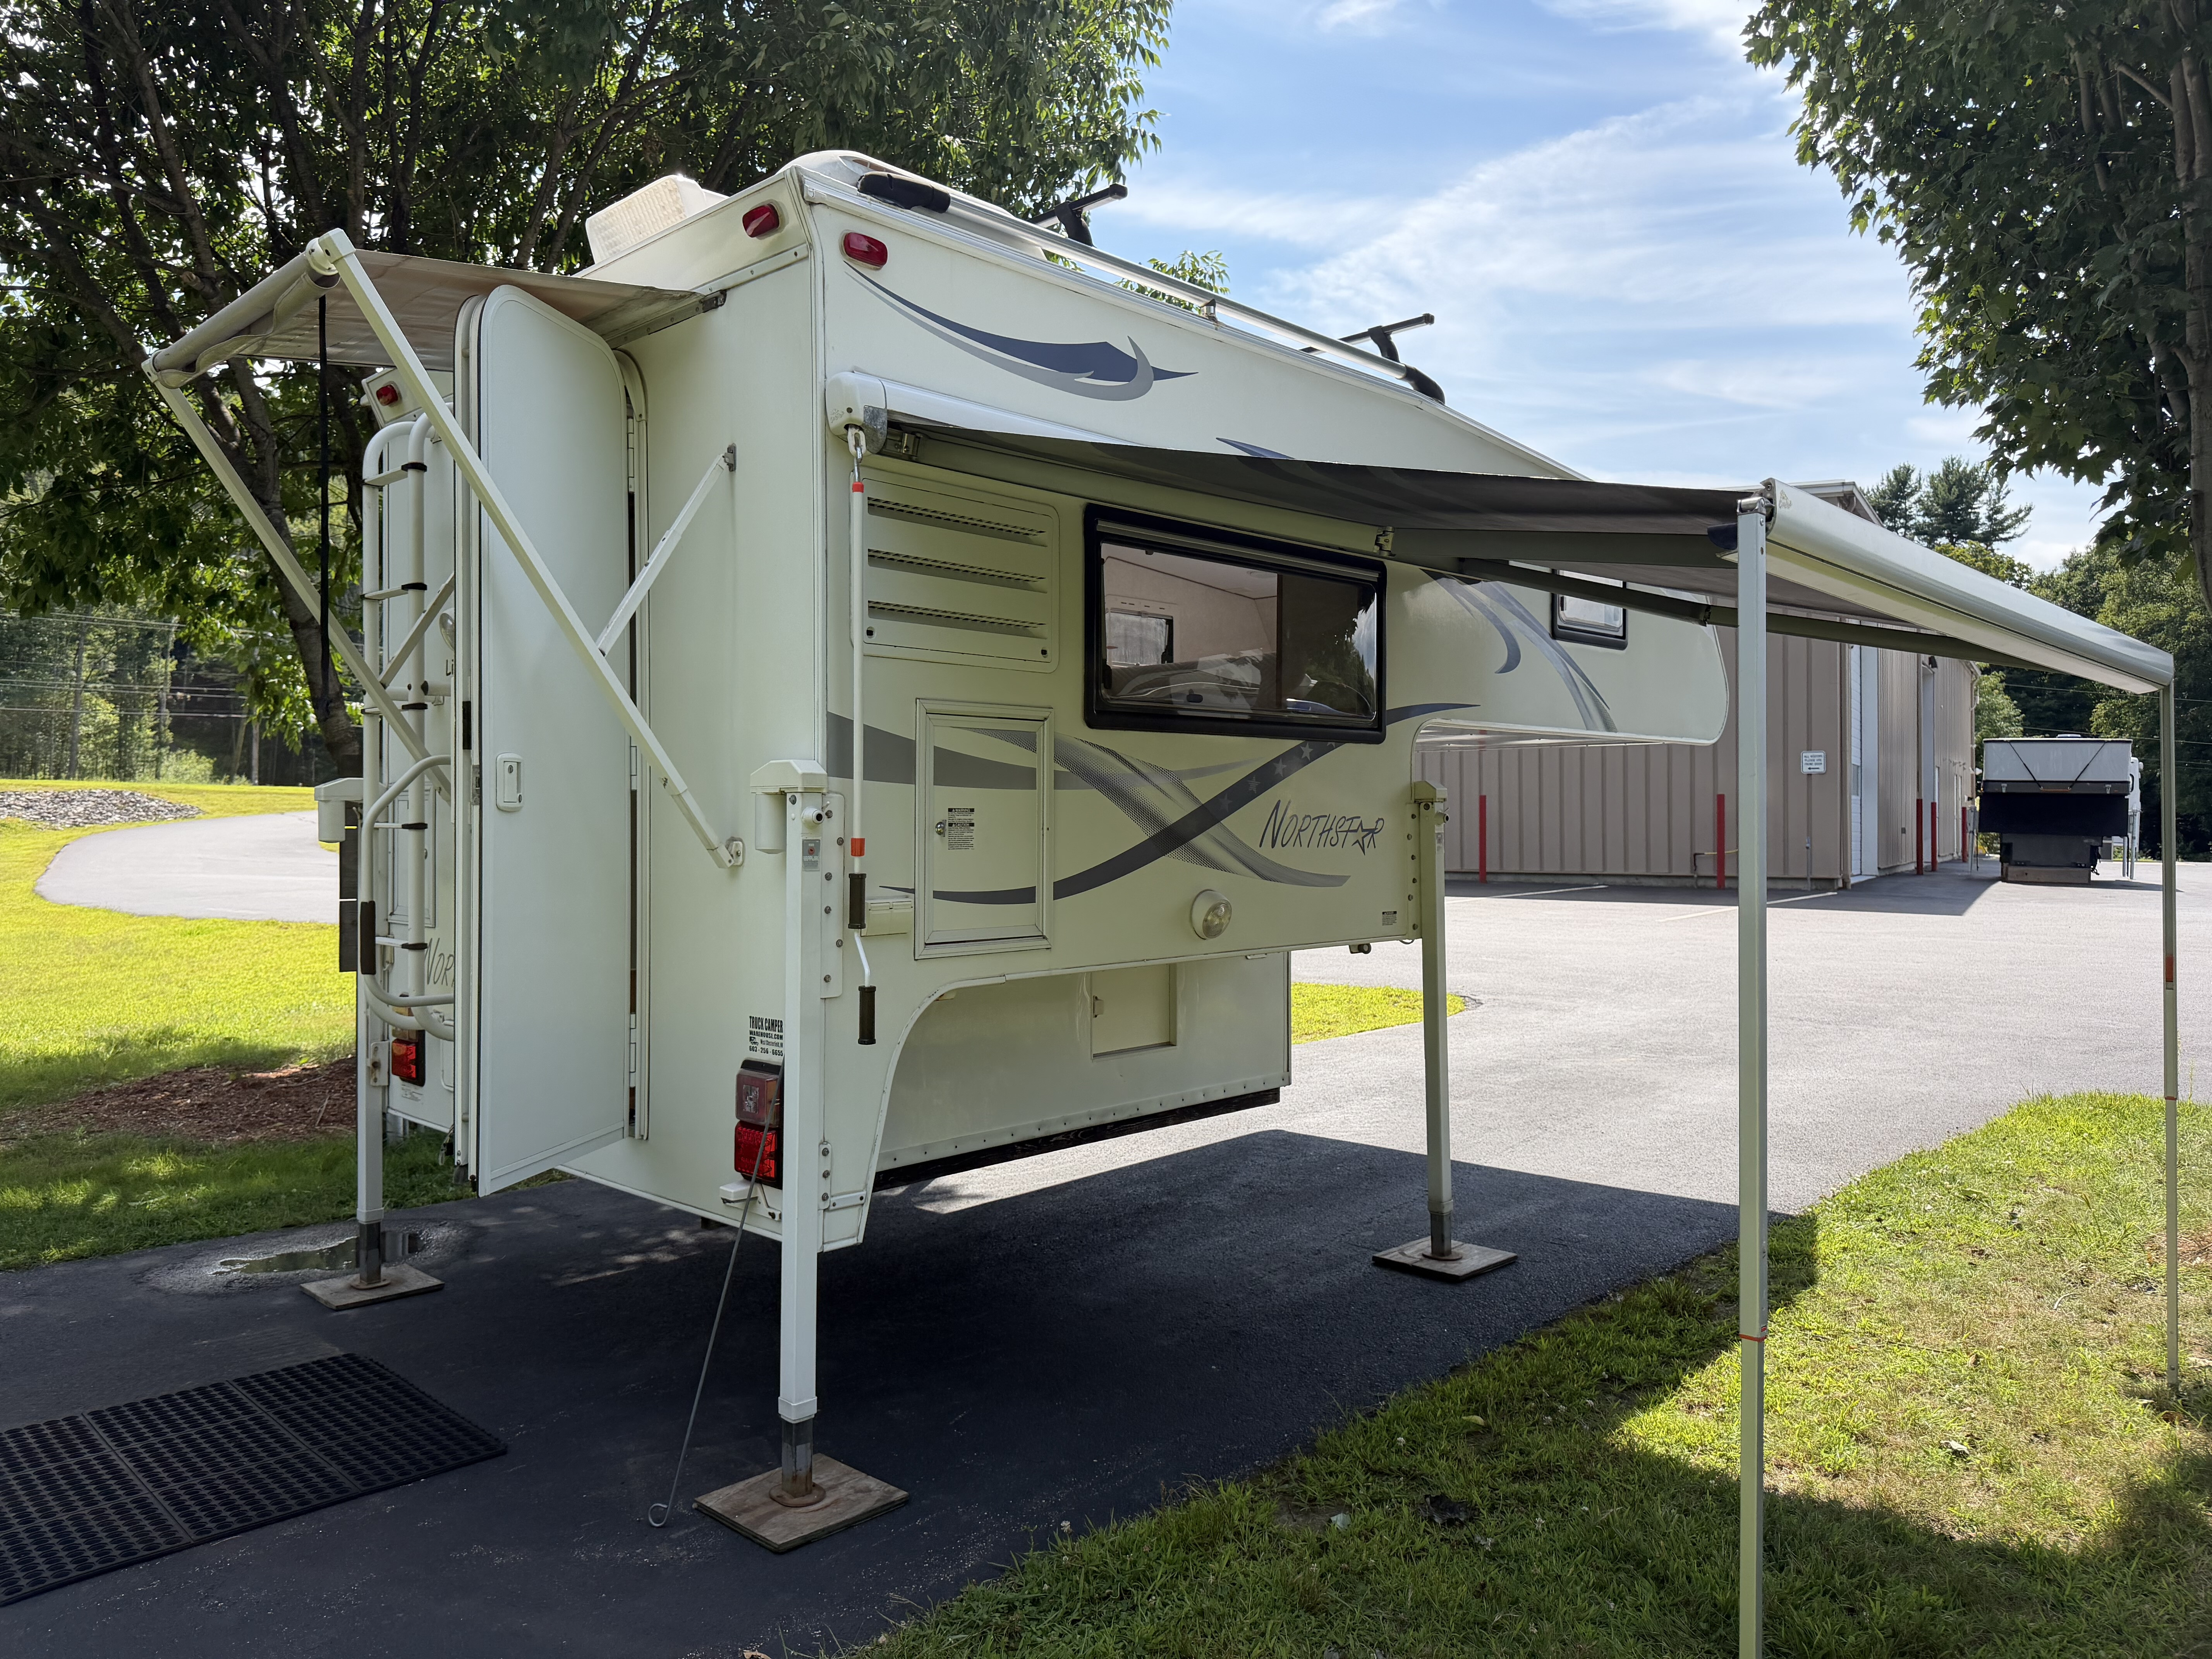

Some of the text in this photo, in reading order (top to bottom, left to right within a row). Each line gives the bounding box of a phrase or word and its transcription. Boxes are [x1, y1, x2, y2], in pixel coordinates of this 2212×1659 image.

[424, 938, 454, 988] NOR
[749, 1016, 783, 1033] TRUCK CAMPER
[749, 1030, 783, 1040] WAREHOUSE.COM
